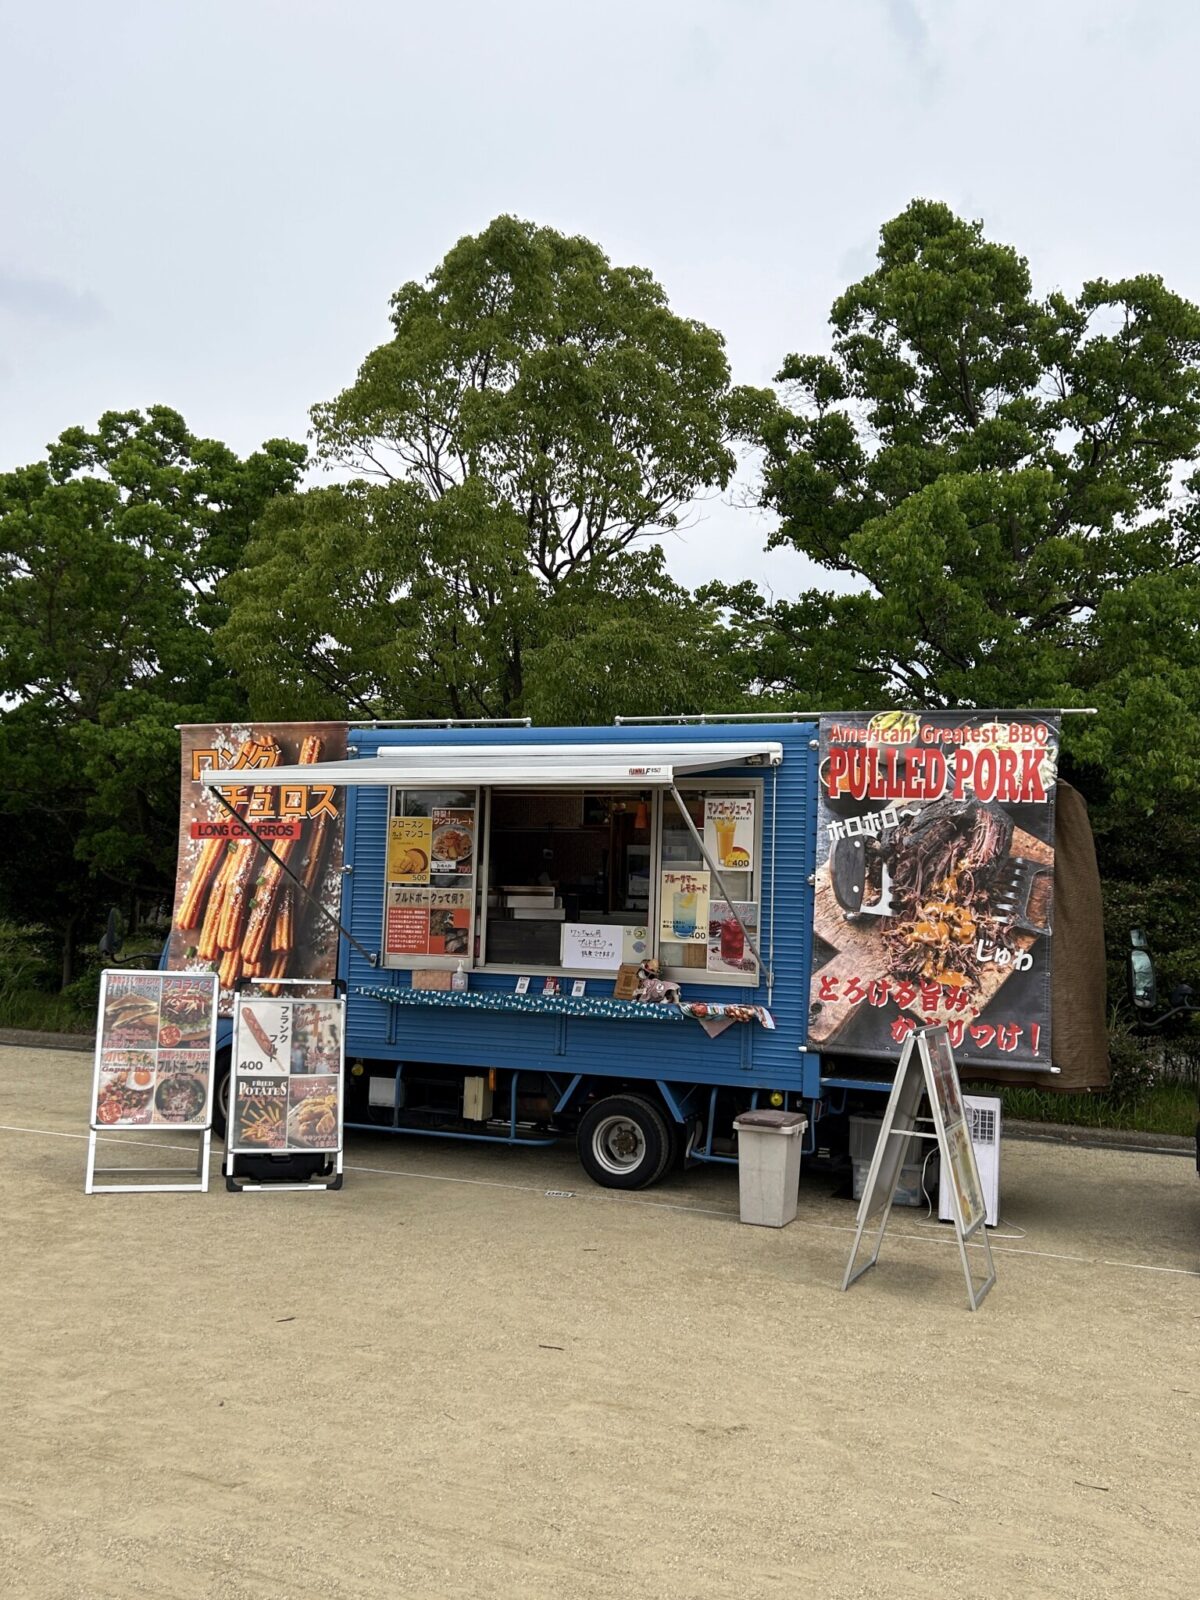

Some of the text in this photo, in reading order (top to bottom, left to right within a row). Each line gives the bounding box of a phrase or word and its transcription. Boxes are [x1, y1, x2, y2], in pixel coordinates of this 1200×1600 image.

[828, 723, 1049, 746] American Greatest BBQ
[825, 746, 1048, 803] PULLED PORK
[198, 825, 229, 837] LONG
[732, 859, 750, 867] 400
[280, 1006, 289, 1044] フランク
[240, 1061, 263, 1070] 400
